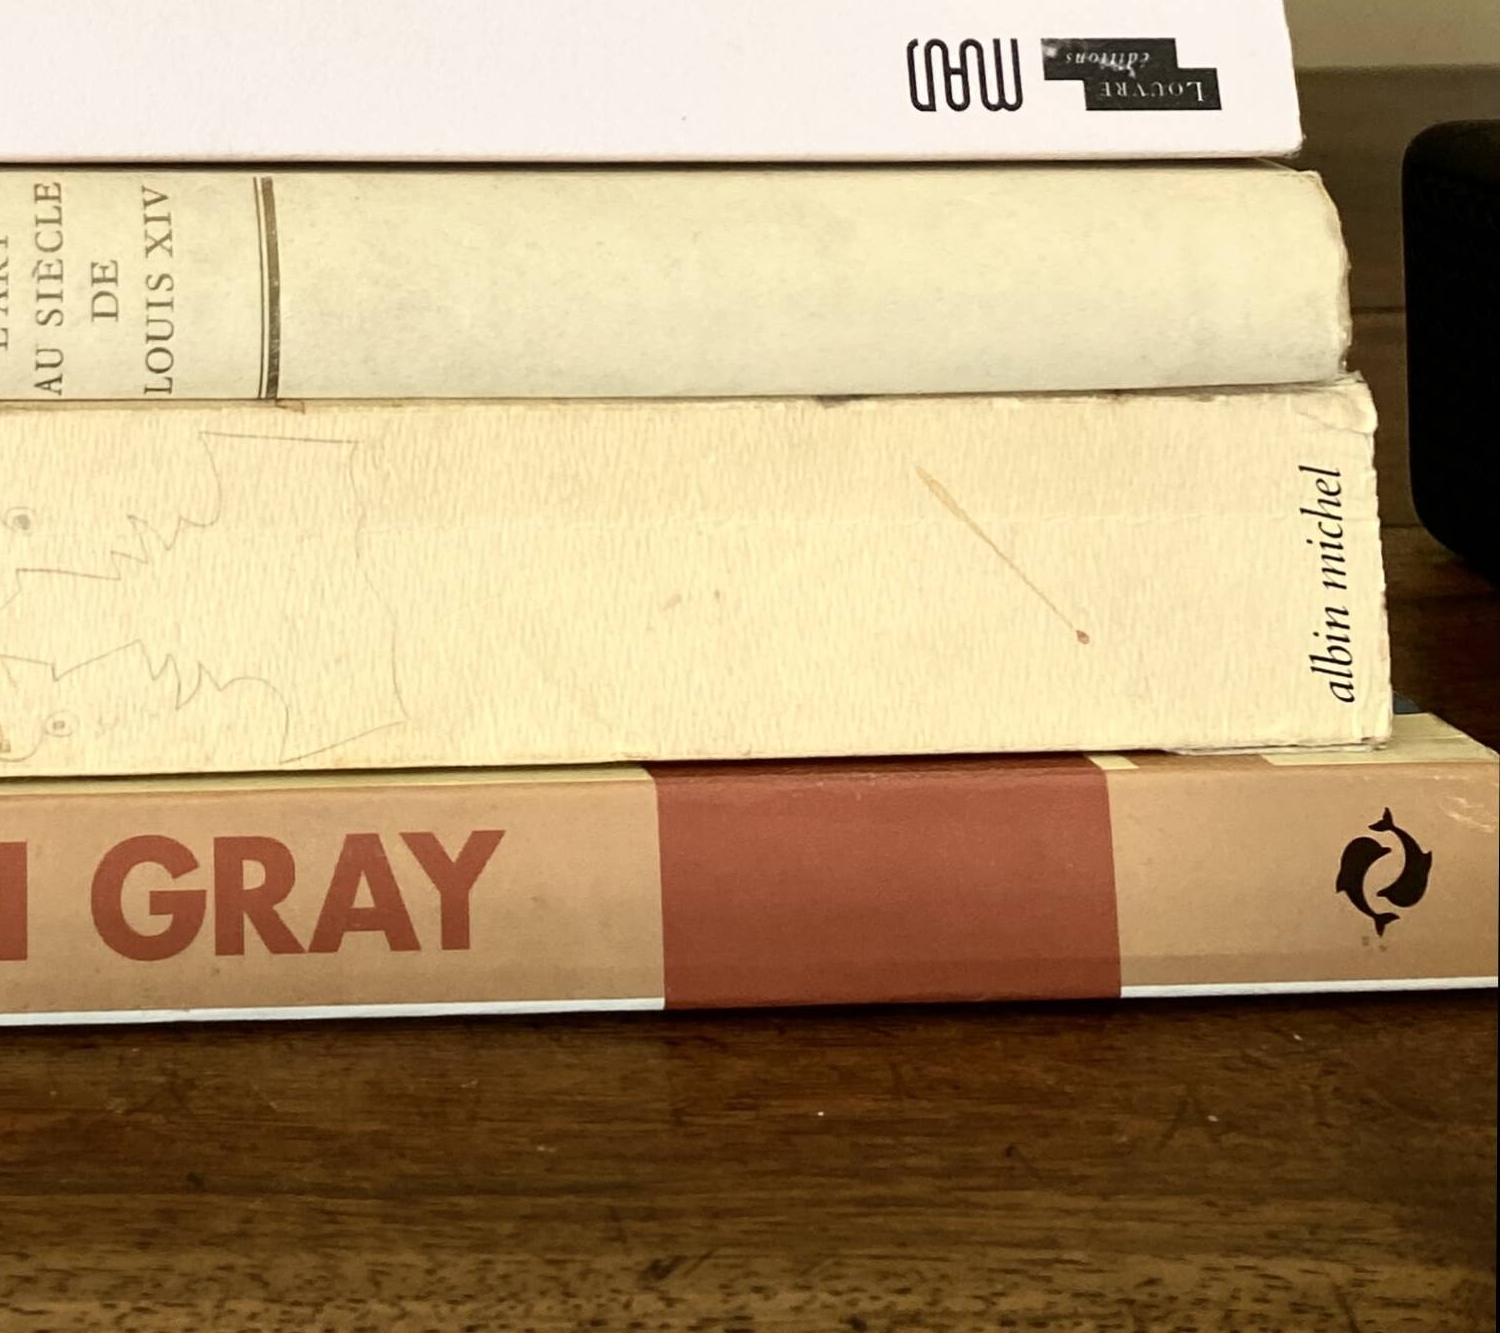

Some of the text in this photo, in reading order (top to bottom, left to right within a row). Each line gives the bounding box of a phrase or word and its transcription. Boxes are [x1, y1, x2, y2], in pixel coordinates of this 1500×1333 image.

[1064, 51, 1151, 68] éditions
[34, 182, 63, 397] AU SIÈCLE
[90, 258, 119, 322] DE
[142, 185, 173, 395] LOUIS XIV
[1299, 466, 1355, 703] albin michel
[89, 829, 505, 962] GRAY
